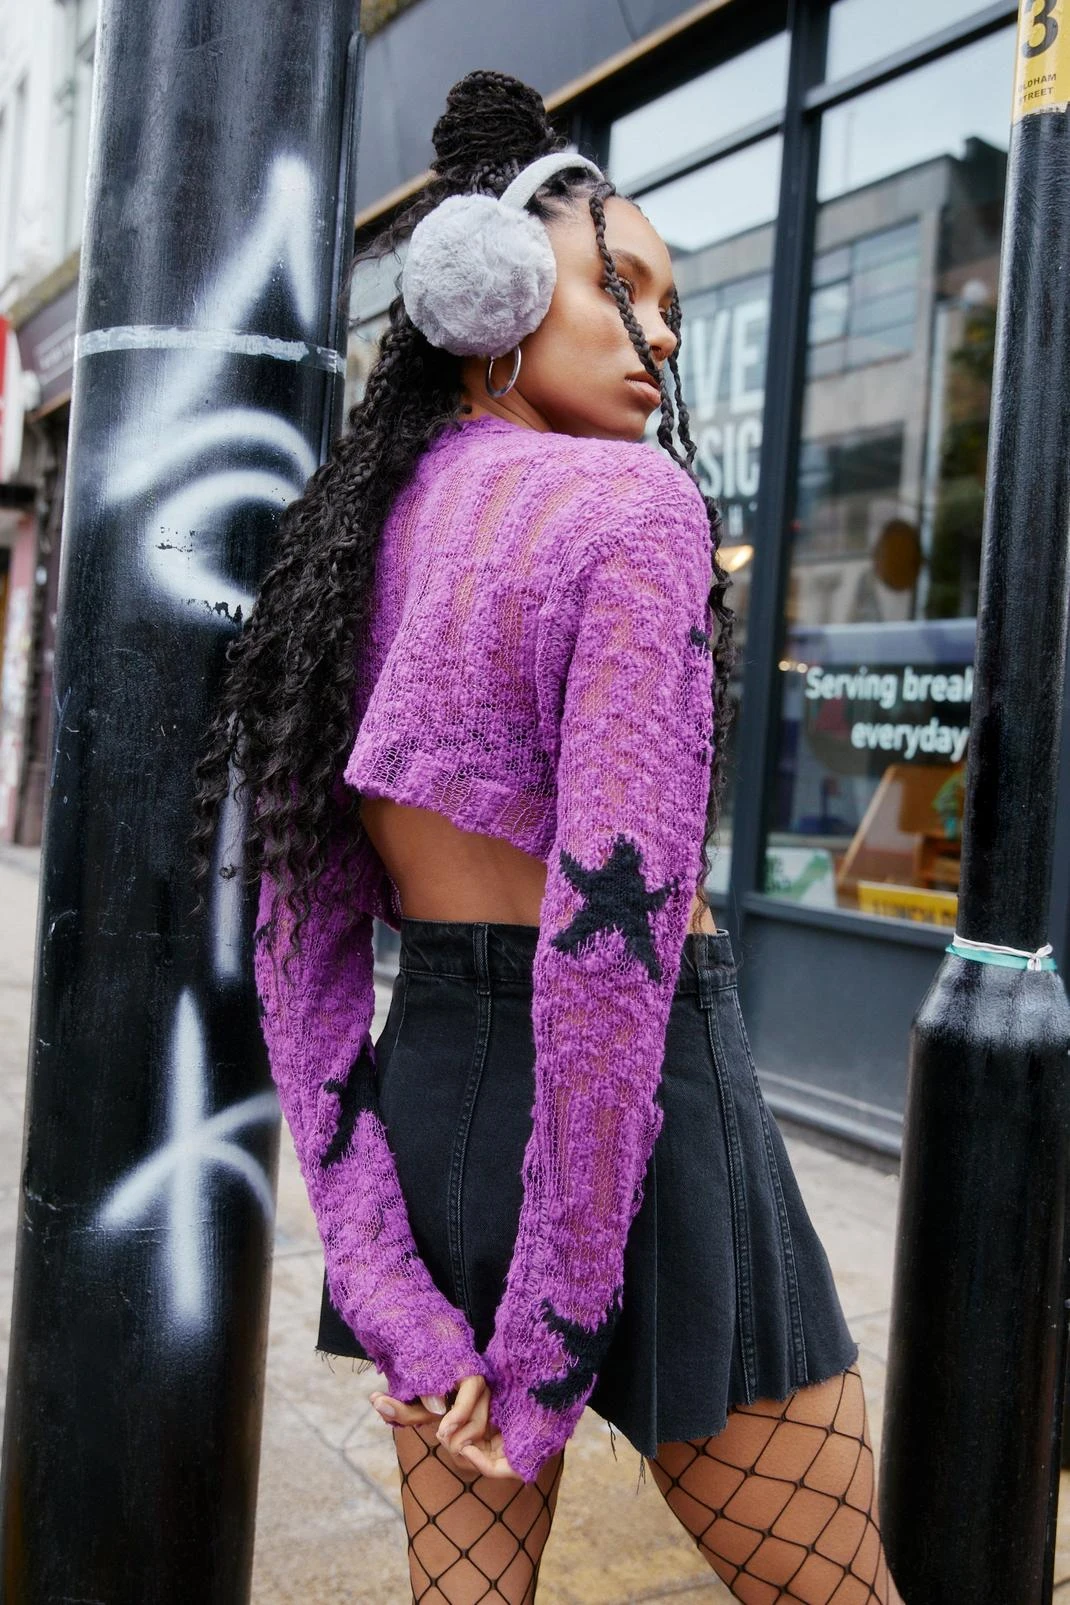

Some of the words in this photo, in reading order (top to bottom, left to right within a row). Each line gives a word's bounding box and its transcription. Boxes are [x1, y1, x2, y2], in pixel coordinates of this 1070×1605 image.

[1021, 0, 1058, 58] 3
[676, 300, 768, 423] IVE
[694, 416, 764, 500] SIC
[805, 665, 898, 709] Serving
[851, 716, 970, 763] everyday
